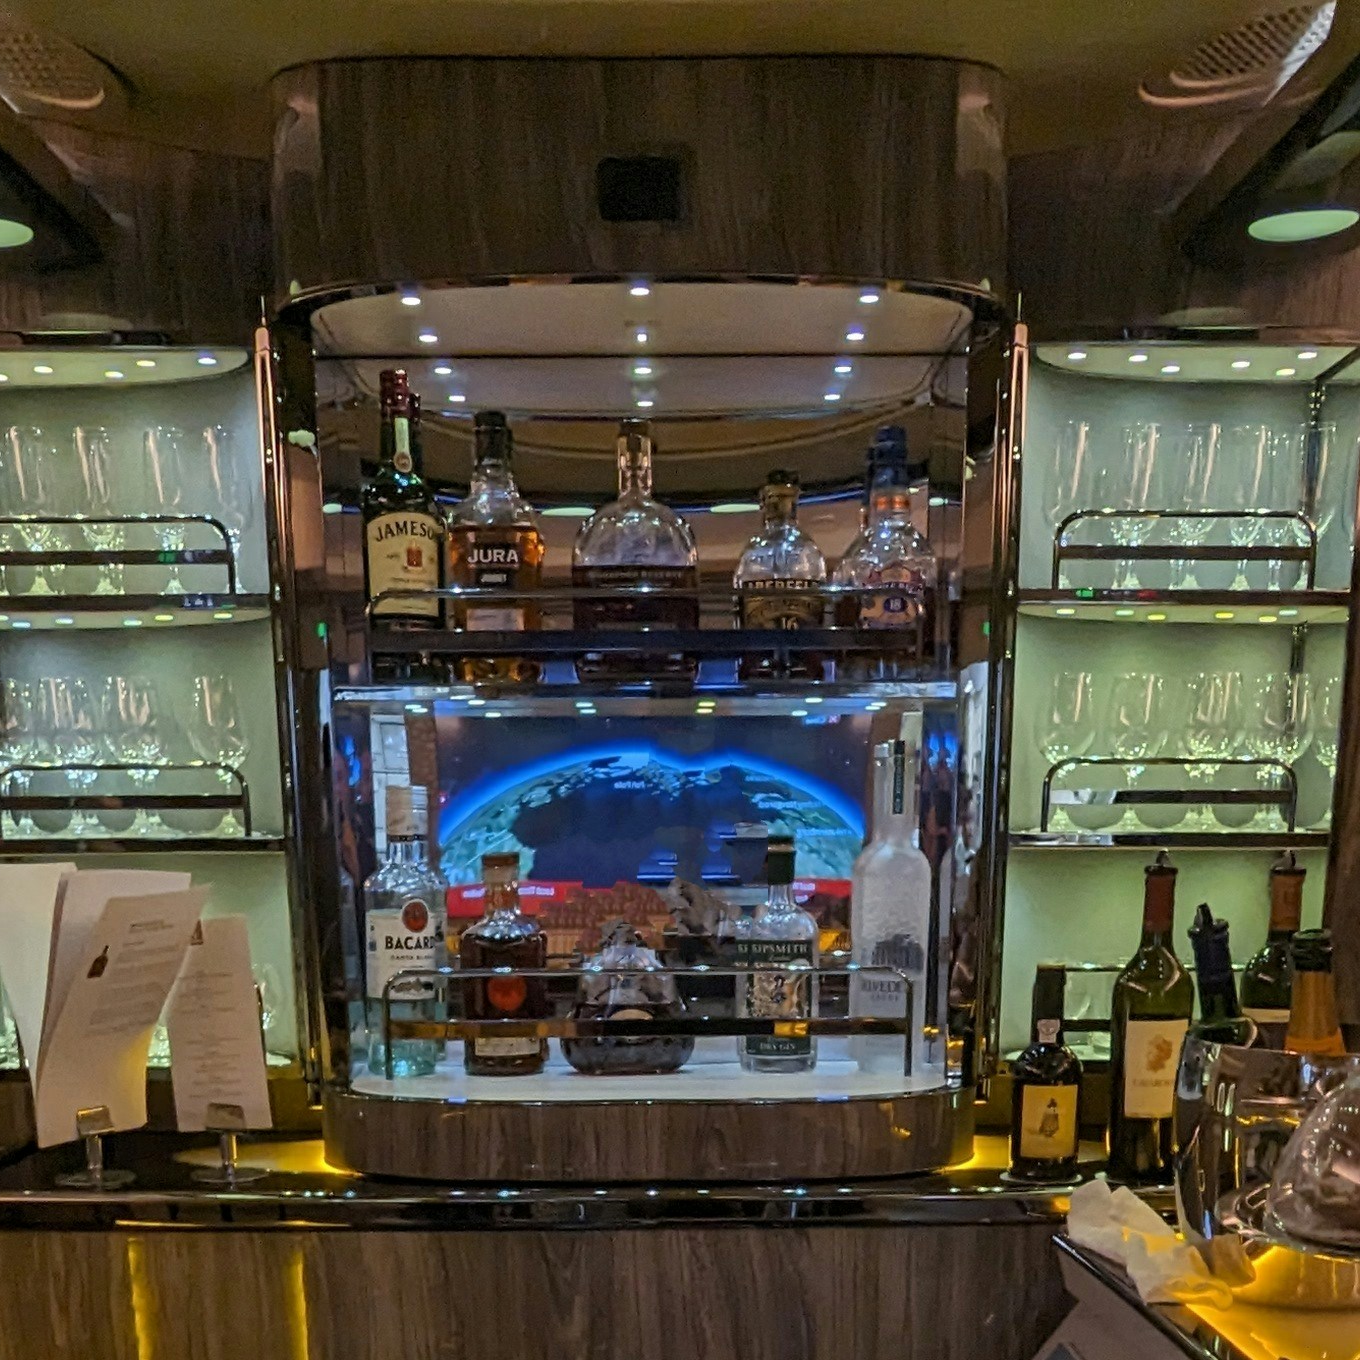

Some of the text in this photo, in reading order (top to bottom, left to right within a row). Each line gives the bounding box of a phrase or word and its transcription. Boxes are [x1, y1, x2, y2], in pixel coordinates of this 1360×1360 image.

[376, 520, 436, 543] JAMESO
[467, 548, 519, 564] JURA
[384, 935, 436, 950] BACAR
